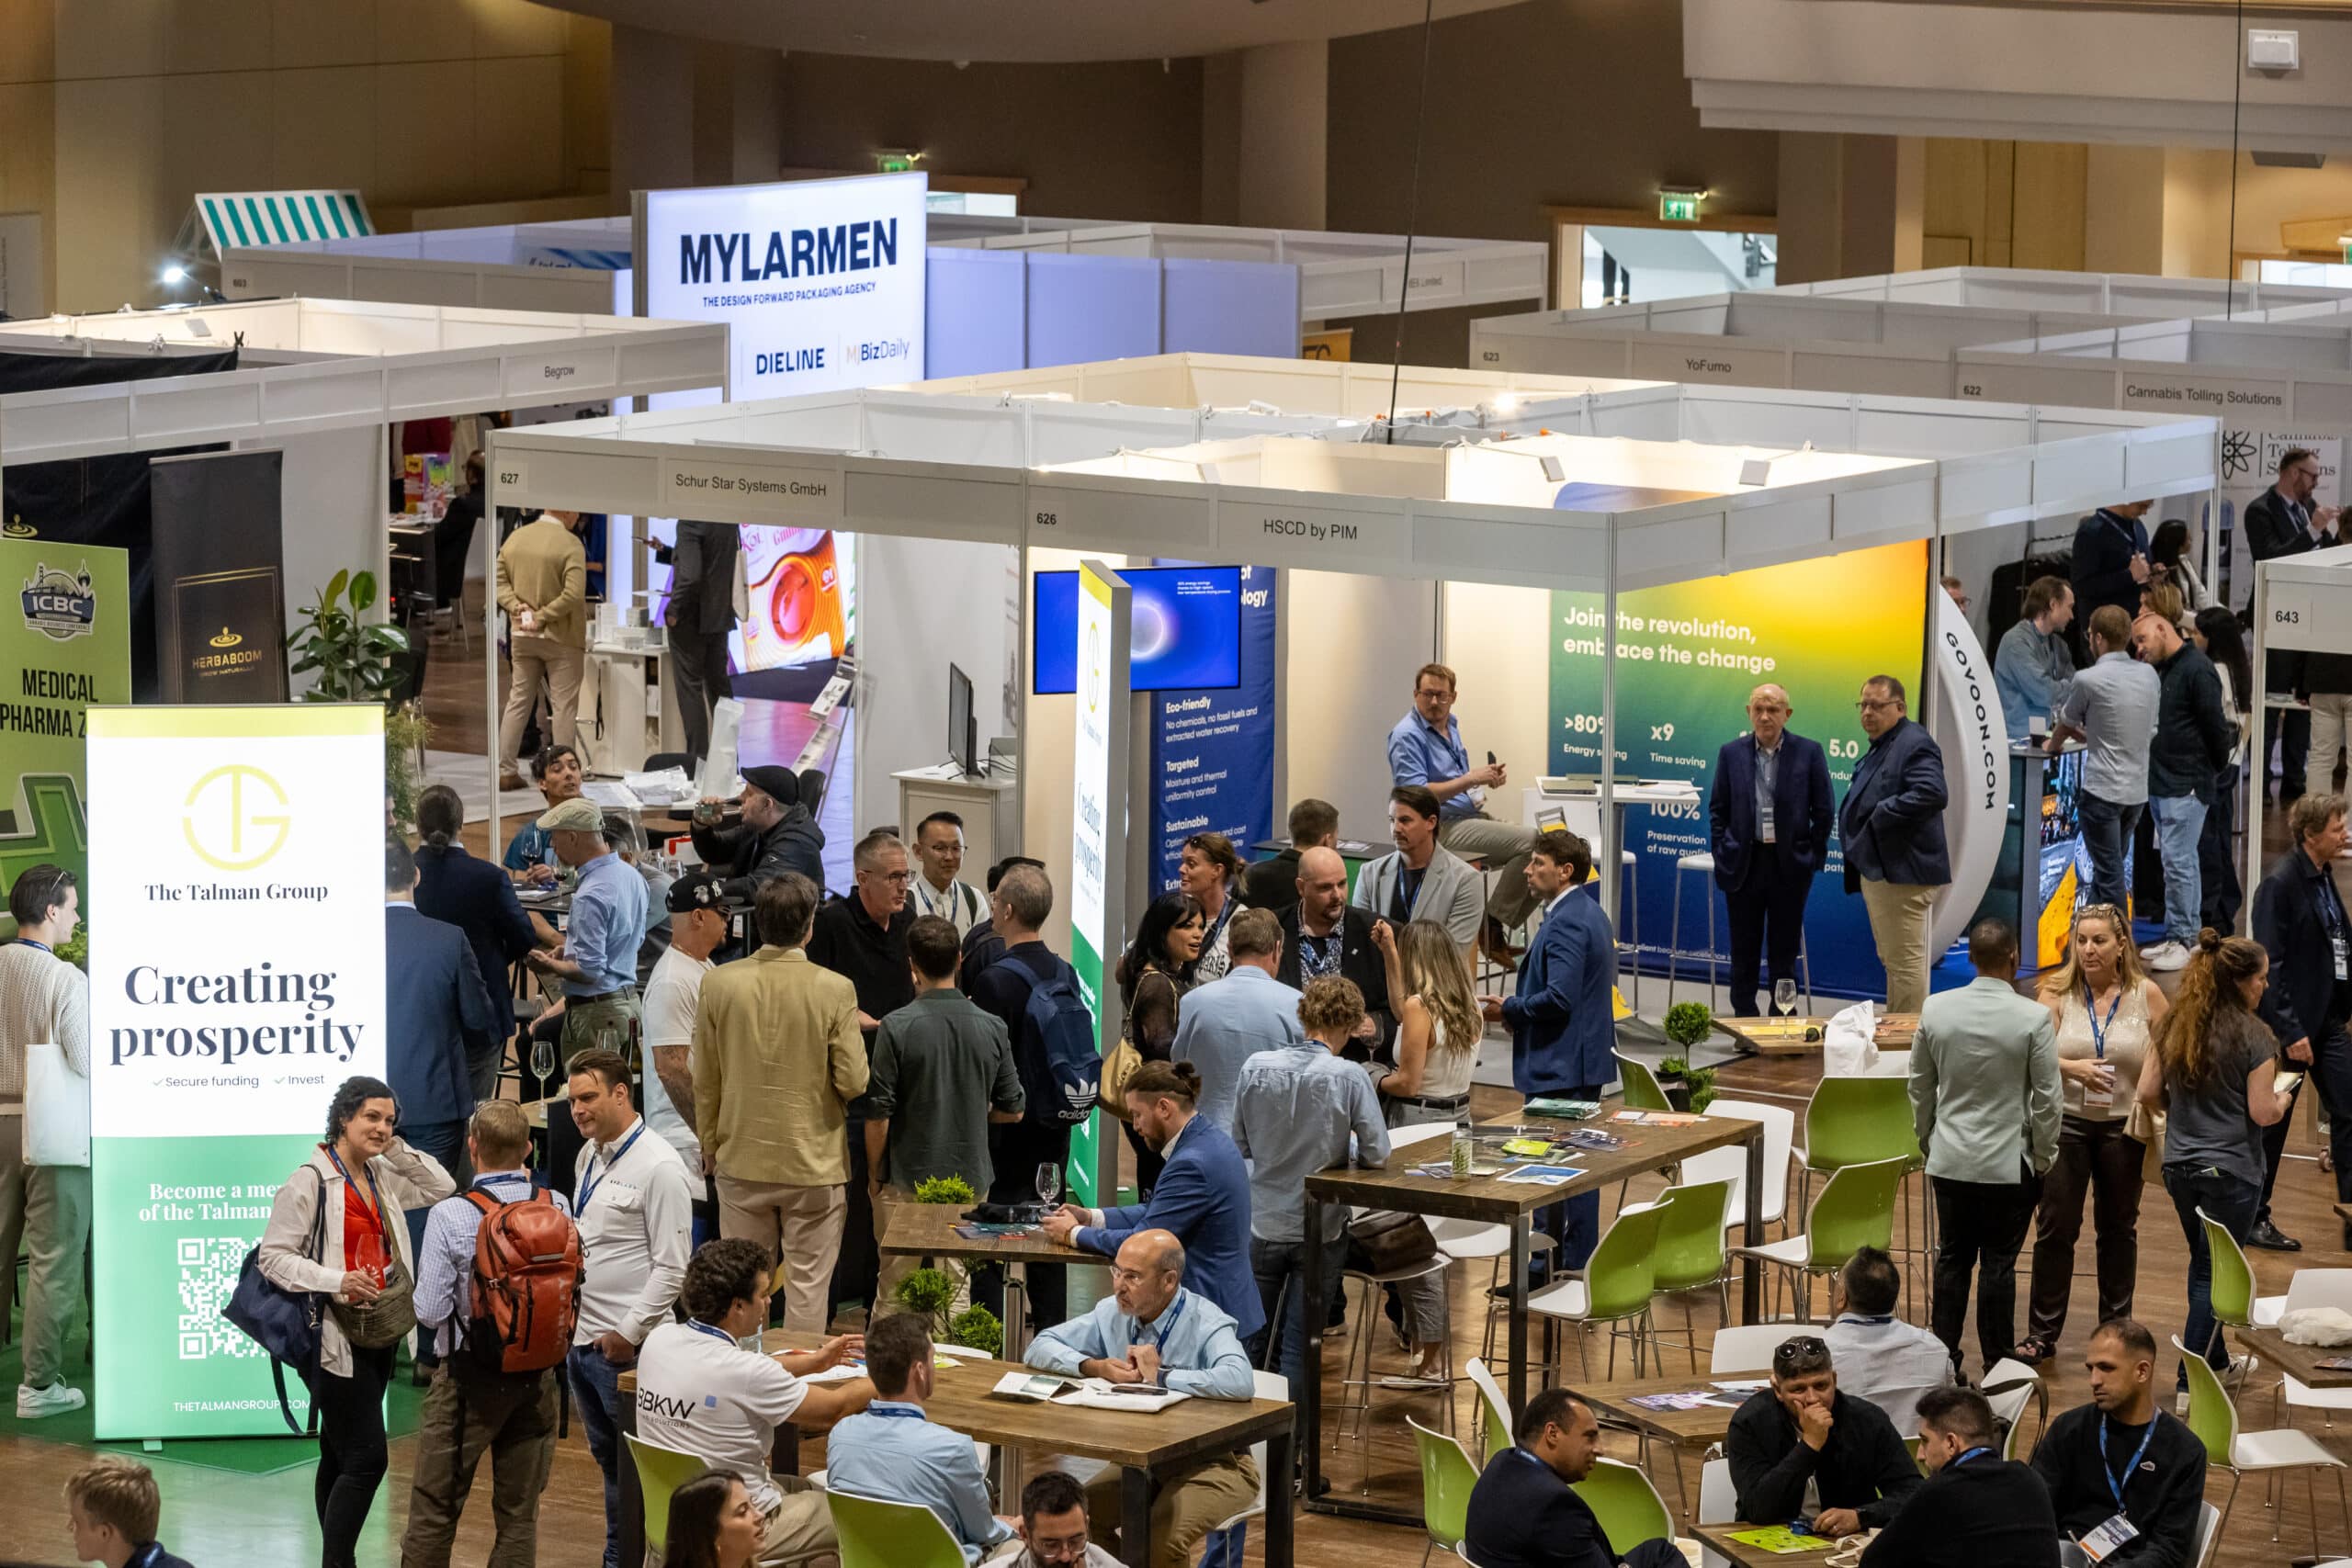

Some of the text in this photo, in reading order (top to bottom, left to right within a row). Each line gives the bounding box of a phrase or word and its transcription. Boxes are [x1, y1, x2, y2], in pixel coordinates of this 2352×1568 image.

[680, 218, 897, 284] MYLARMEN
[703, 282, 876, 307] THE DESIGN FORWARD PACKAGING AGENCY
[756, 348, 825, 375] DIELINE
[1483, 352, 1499, 362] 623
[1686, 359, 1732, 373] YoFumo
[544, 366, 575, 380] Begrow
[1963, 386, 1982, 396] 622
[2126, 385, 2282, 406] Cannabis Tolling Solutions
[501, 473, 519, 484] 627
[675, 473, 826, 496] Schur Star Systems GmbH
[1036, 513, 1057, 525] 626
[1264, 519, 1358, 541] HSCD by PIM
[32, 595, 83, 615] ICBC
[1564, 606, 1605, 626] Join
[1648, 617, 1757, 645] revolution,
[2275, 610, 2300, 624] 643
[192, 649, 263, 670] HERBABOOM
[1564, 638, 1776, 674] embace the change
[22, 668, 98, 703] MEDICAL
[1166, 696, 1212, 714] Eco-friendly
[0, 703, 74, 738] PHARMA
[1166, 705, 1258, 730] No chemicals, no fossil fuels and
[1946, 632, 1996, 810] GOVOON.COM
[1166, 724, 1240, 743] extracted water recovery
[1650, 723, 1675, 742] x9
[1564, 743, 1595, 758] Energy
[1828, 739, 1860, 760] 5.0
[1166, 756, 1199, 773] Targeted
[1650, 751, 1706, 769] Time saving
[1165, 769, 1227, 789] Moisture and thermal
[1165, 784, 1217, 803] uniformity control
[1650, 802, 1701, 821] 100%
[1166, 816, 1209, 833] Sustainable
[1647, 830, 1707, 845] Preservation
[1647, 844, 1657, 853] of
[1658, 846, 1678, 856] raw
[145, 883, 328, 902] The Talman Group
[125, 962, 337, 1011] Creating
[109, 1013, 365, 1066] prosperity
[165, 1076, 260, 1089] Secure funding
[288, 1075, 324, 1086] Invest
[1057, 1108, 1090, 1121] adida
[150, 1183, 226, 1201] Become
[231, 1186, 242, 1199] a
[139, 1201, 272, 1222] of the Talman
